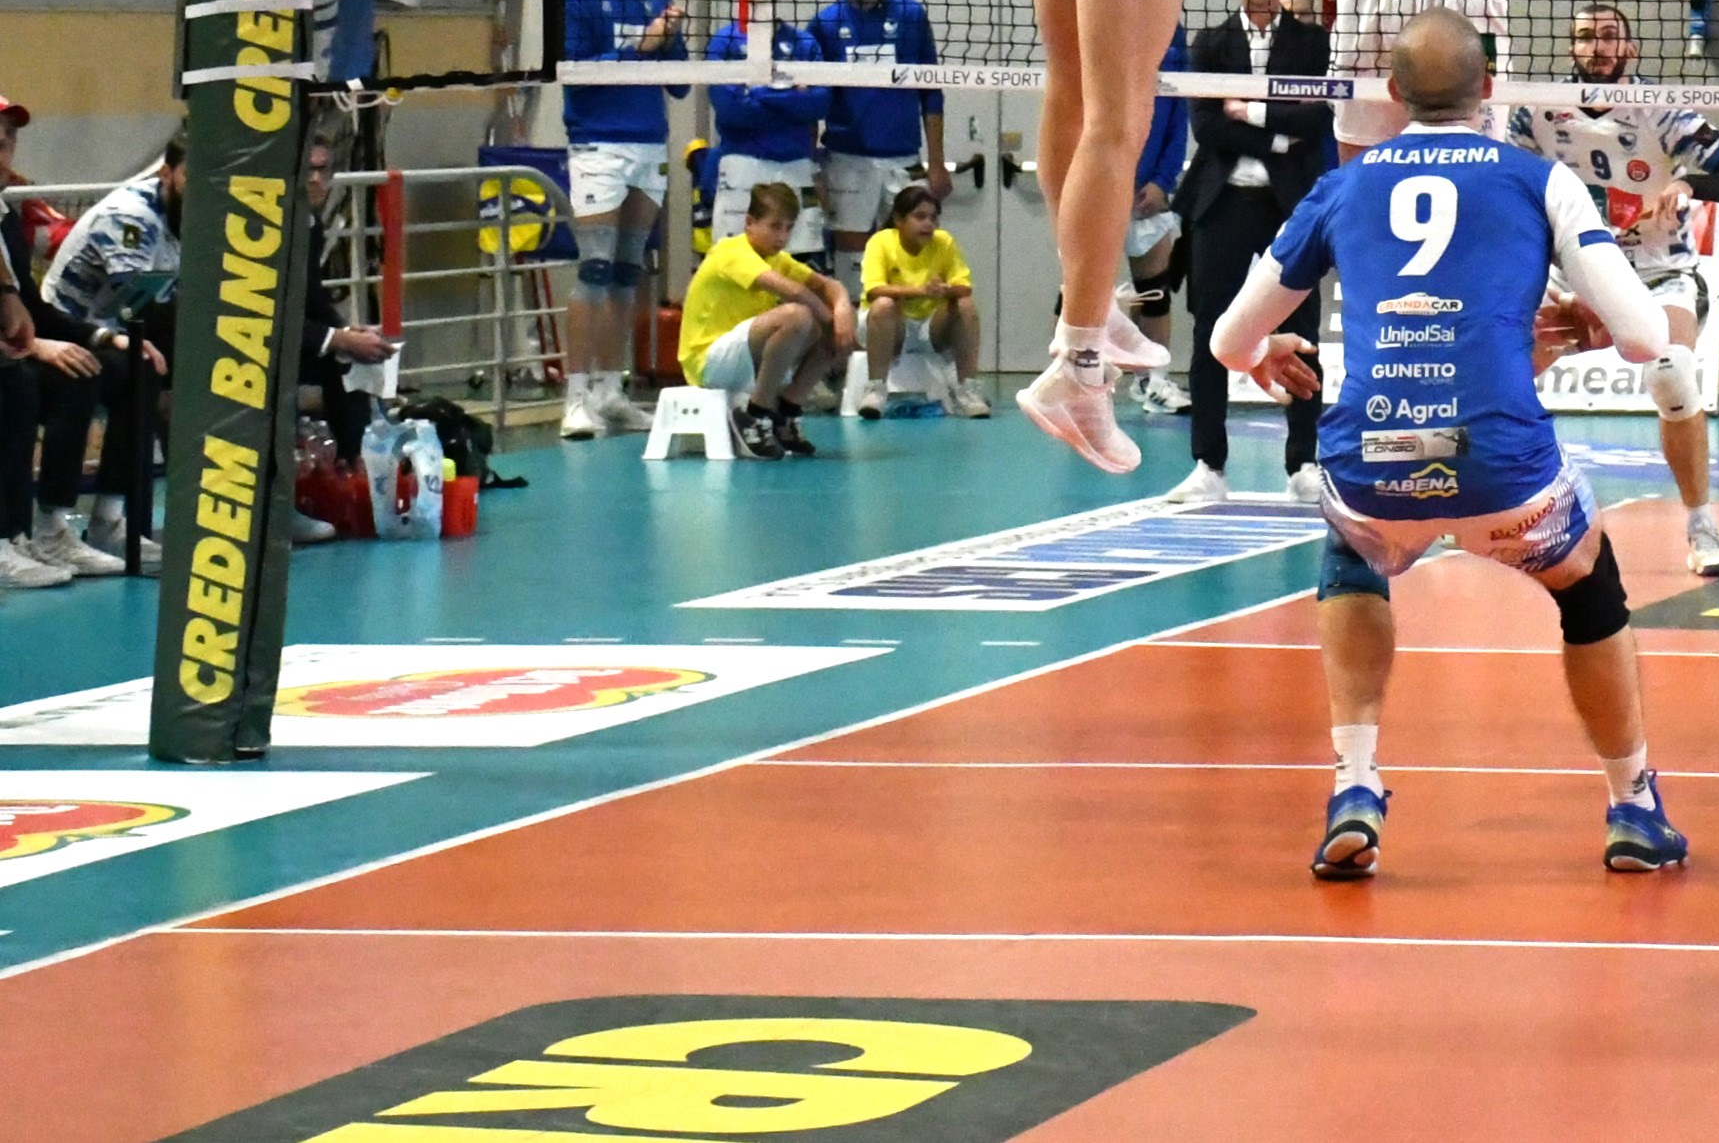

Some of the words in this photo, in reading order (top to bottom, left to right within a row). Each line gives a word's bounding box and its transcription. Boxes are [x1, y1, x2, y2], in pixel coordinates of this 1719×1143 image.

[912, 68, 971, 86] VOLLEY
[976, 68, 986, 86] &
[990, 68, 1042, 87] SPORT
[1270, 79, 1328, 97] luanvi
[1603, 89, 1660, 105] VOLLEY
[1665, 89, 1678, 105] &
[1362, 146, 1500, 165] GALAVERNA
[1590, 149, 1612, 180] 9
[1389, 174, 1459, 277] 9
[210, 175, 287, 411] BANCA
[1378, 324, 1456, 346] UnipolSai
[1371, 362, 1457, 380] GUNETTO
[1394, 396, 1458, 425] Agral
[1373, 477, 1459, 493] SABENA
[178, 434, 260, 706] CREDEM
